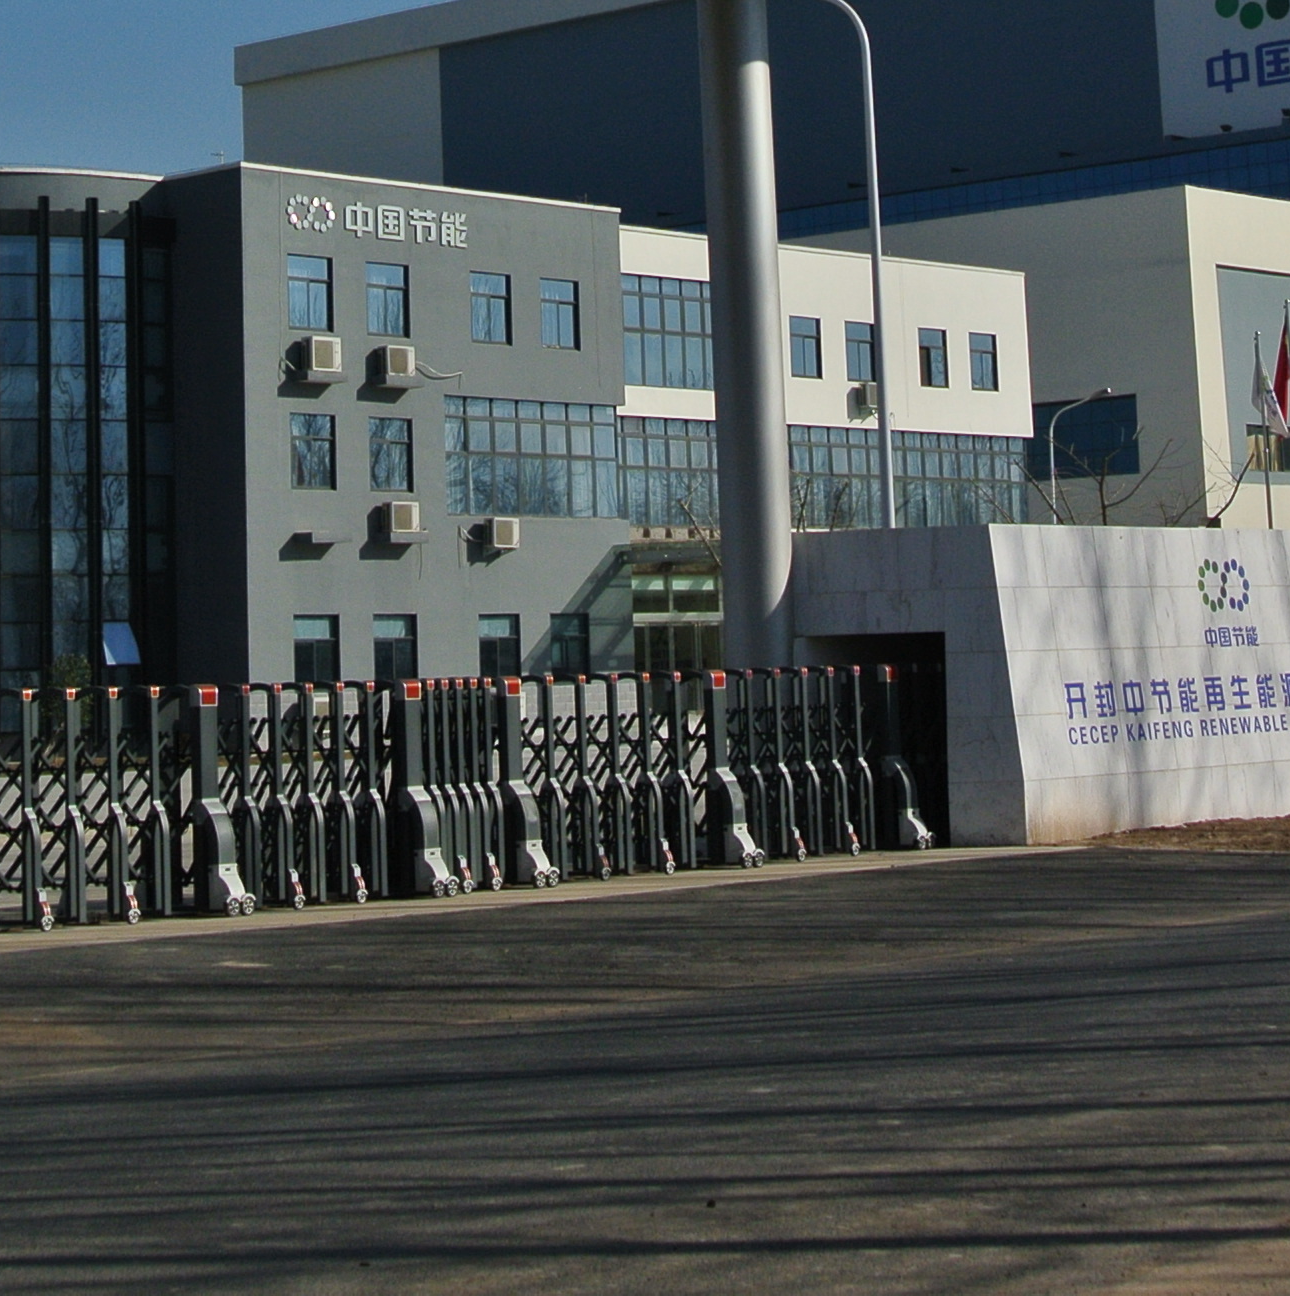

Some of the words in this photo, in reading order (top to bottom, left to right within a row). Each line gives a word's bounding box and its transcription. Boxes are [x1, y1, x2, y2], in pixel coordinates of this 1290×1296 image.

[343, 201, 468, 249] 中国节能
[1204, 625, 1260, 648] 中国节能
[1068, 724, 1119, 745] CECEP
[1126, 720, 1194, 742] KAIFENG
[1199, 714, 1289, 737] RENEWABLE
